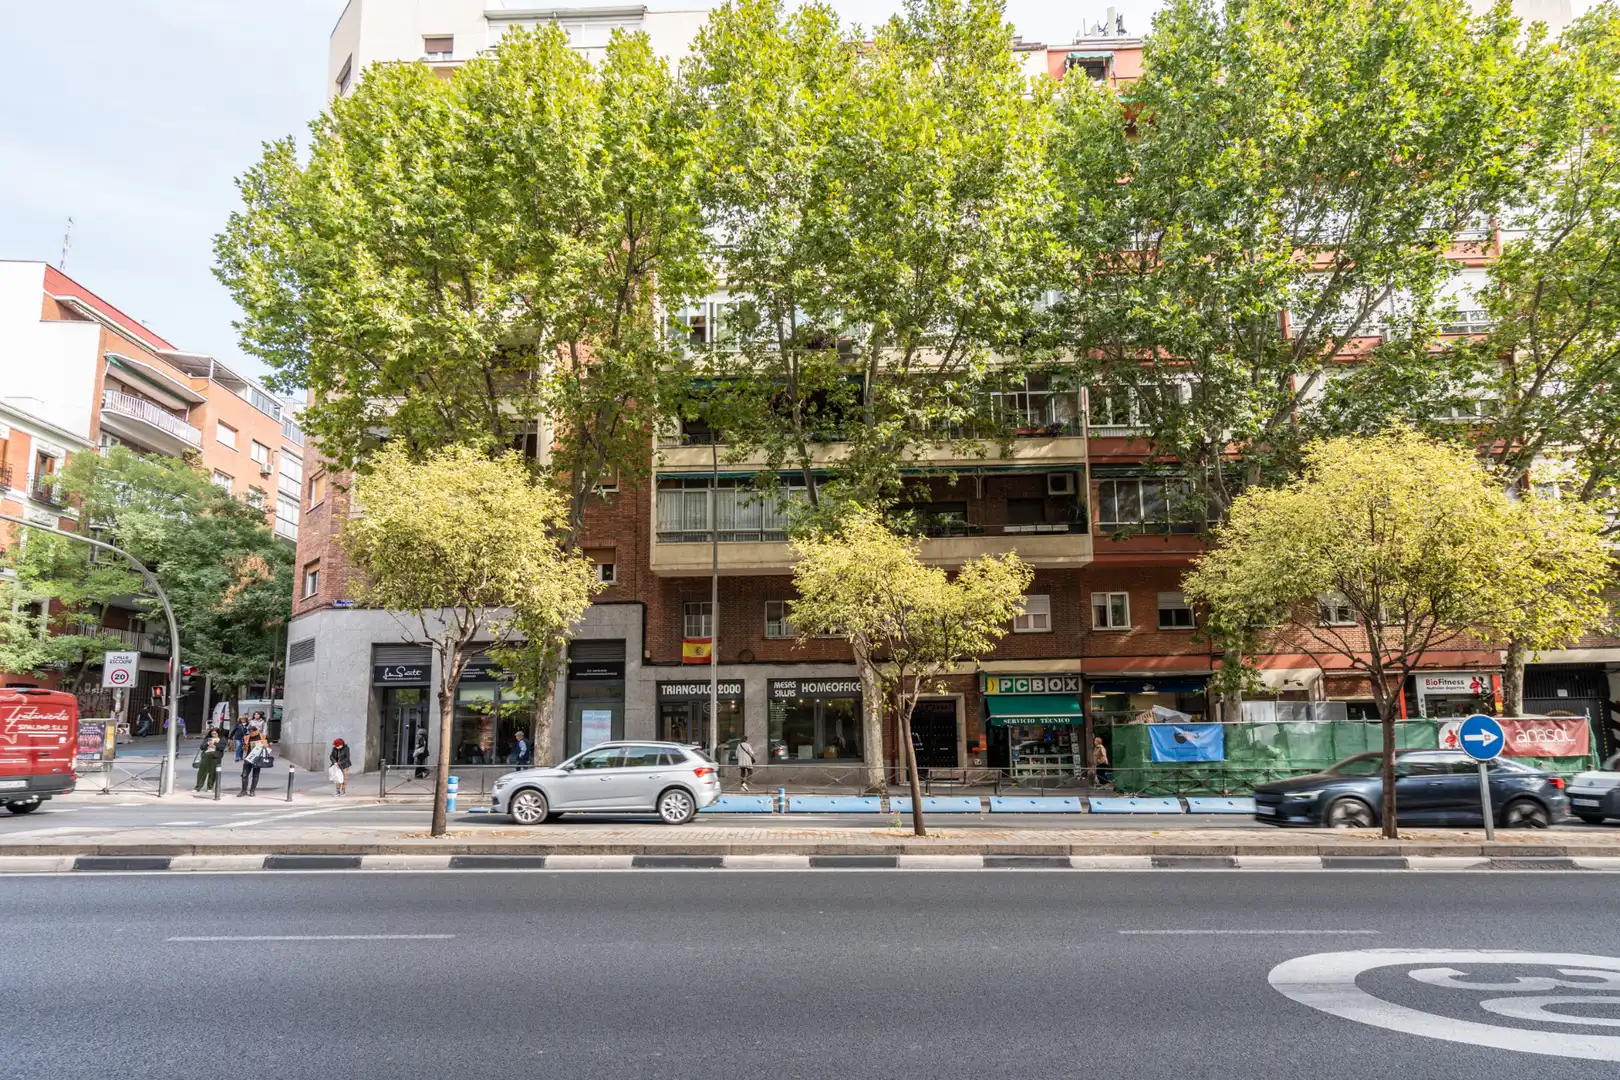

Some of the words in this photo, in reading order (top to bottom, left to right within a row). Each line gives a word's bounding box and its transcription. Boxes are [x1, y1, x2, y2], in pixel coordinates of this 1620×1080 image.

[773, 681, 797, 689] MESAS
[1425, 678, 1464, 686] BioFitness
[717, 684, 741, 694] 2000
[774, 689, 797, 697] SILLAS
